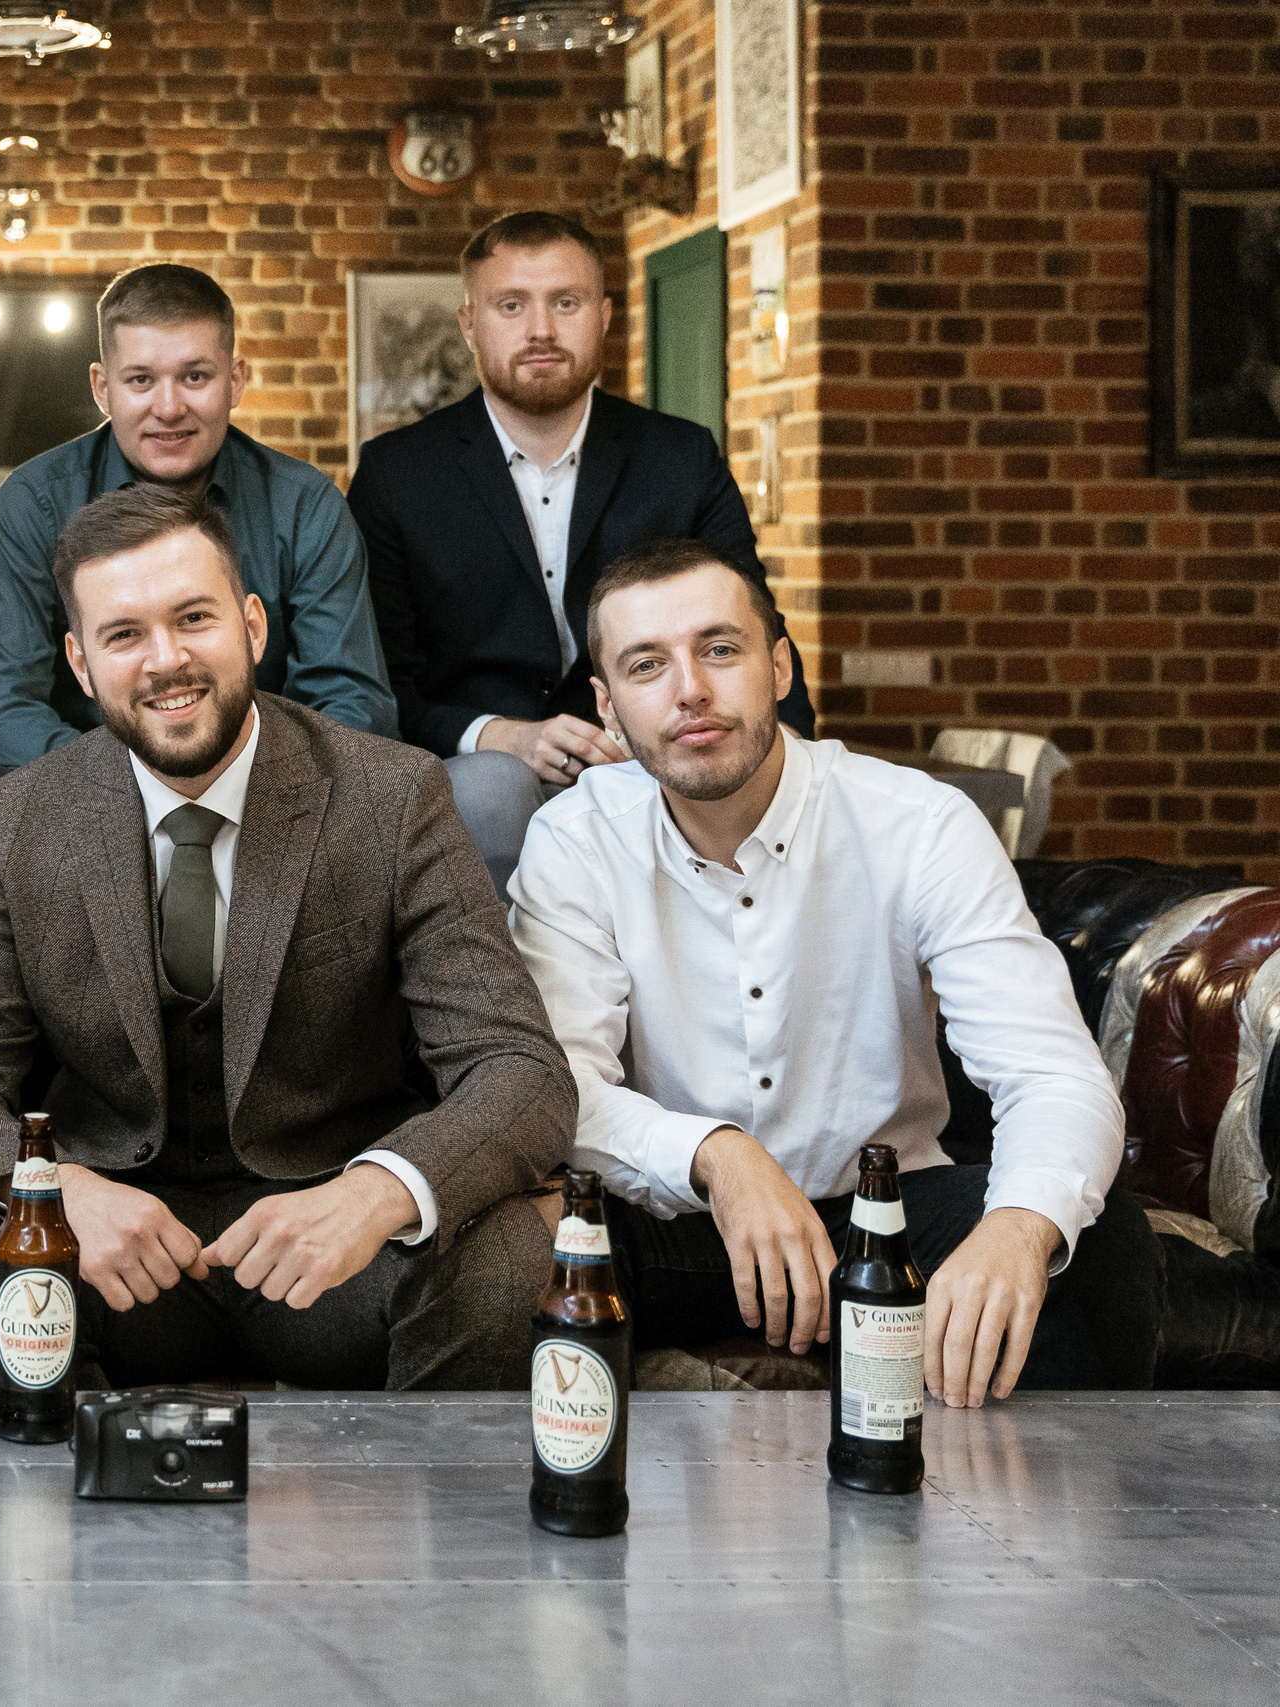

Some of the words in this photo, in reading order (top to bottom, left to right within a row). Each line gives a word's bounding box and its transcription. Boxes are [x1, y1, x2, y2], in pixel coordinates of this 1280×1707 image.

[420, 142, 460, 176] 66
[872, 1309, 924, 1323] GUINNESS
[1, 1317, 71, 1336] GUINNESS
[878, 1325, 920, 1333] ORIGINAL
[7, 1338, 65, 1349] ORIGINAL
[533, 1389, 607, 1418] GUINNESS
[536, 1412, 598, 1432] ORIGINAL
[186, 1438, 223, 1446] OLYMPUS
[552, 1454, 567, 1463] AND
